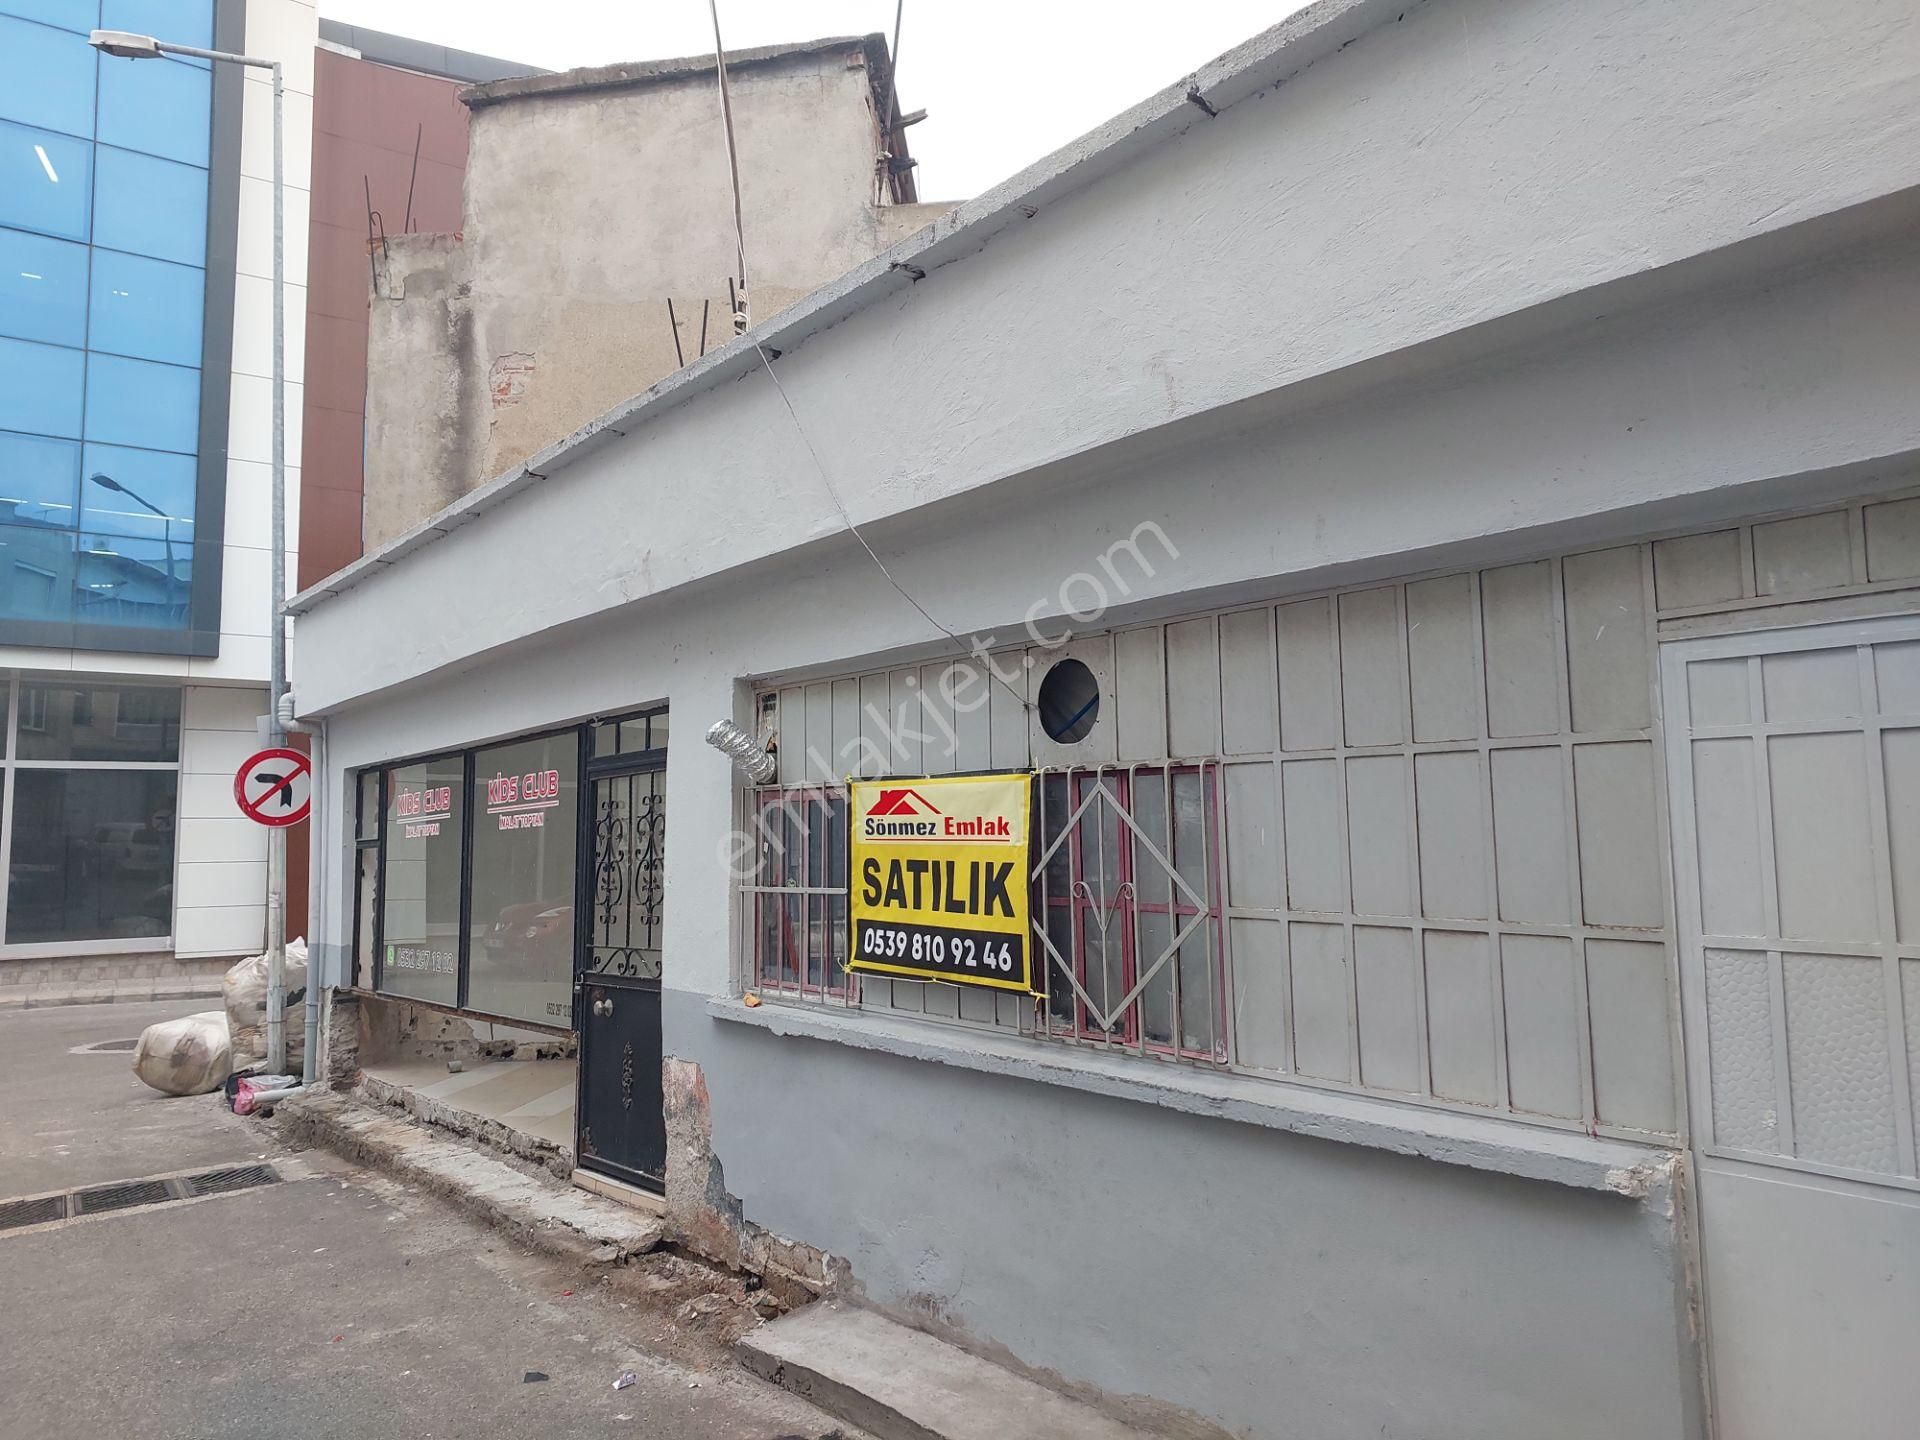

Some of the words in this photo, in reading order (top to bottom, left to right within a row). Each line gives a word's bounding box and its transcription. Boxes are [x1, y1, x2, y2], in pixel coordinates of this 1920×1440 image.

[423, 786, 450, 813] CLUB
[522, 769, 559, 800] CLUB
[865, 817, 937, 836] Sönmez
[944, 816, 1010, 836] Emlak
[862, 857, 1016, 918] SATILIK
[864, 927, 908, 957] 0539
[911, 933, 945, 964] 810
[950, 937, 977, 967] 92
[982, 941, 1012, 972] 46
